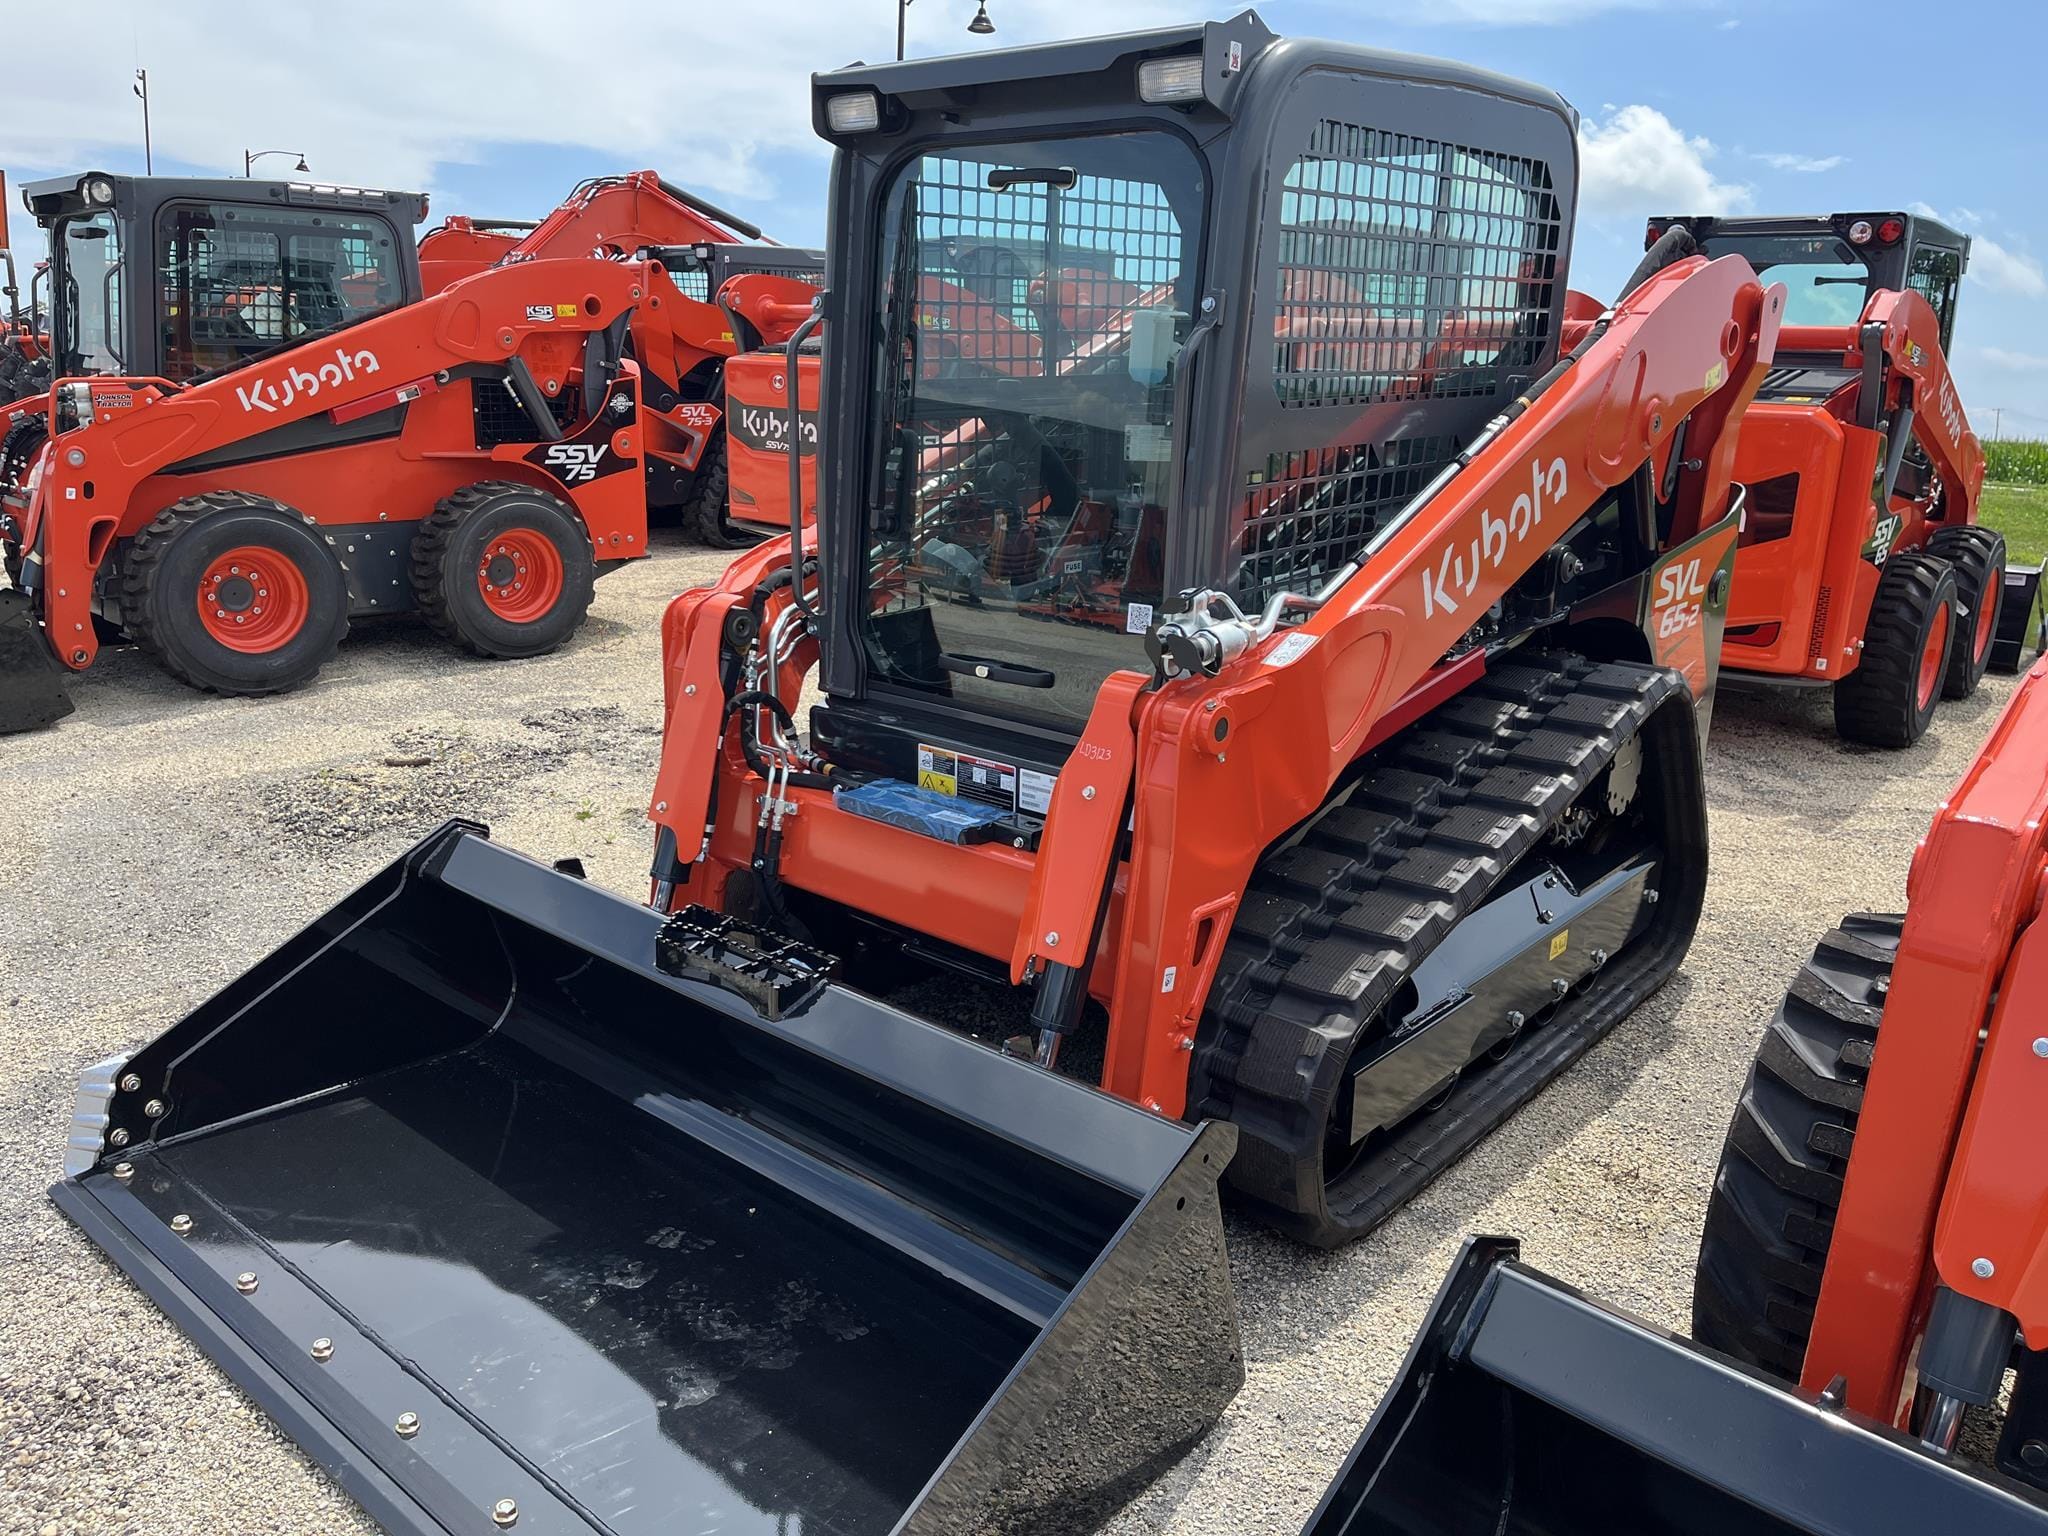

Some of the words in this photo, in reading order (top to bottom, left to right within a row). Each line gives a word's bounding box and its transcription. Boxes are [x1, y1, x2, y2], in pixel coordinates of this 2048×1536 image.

[526, 305, 554, 317] KSR
[235, 349, 380, 413] Kubota
[96, 400, 132, 408] TRACTOR
[681, 406, 711, 417] SVL
[687, 417, 712, 426] 75-3
[544, 444, 609, 465] SSV
[765, 440, 790, 451] SSV7
[565, 464, 597, 480] 75
[1422, 457, 1567, 620] Kubota
[1871, 515, 1898, 548] SSV
[1874, 542, 1890, 566] 65
[1065, 562, 1081, 571] FUSE
[1655, 558, 1704, 608] SVL
[1659, 601, 1700, 638] 65-2
